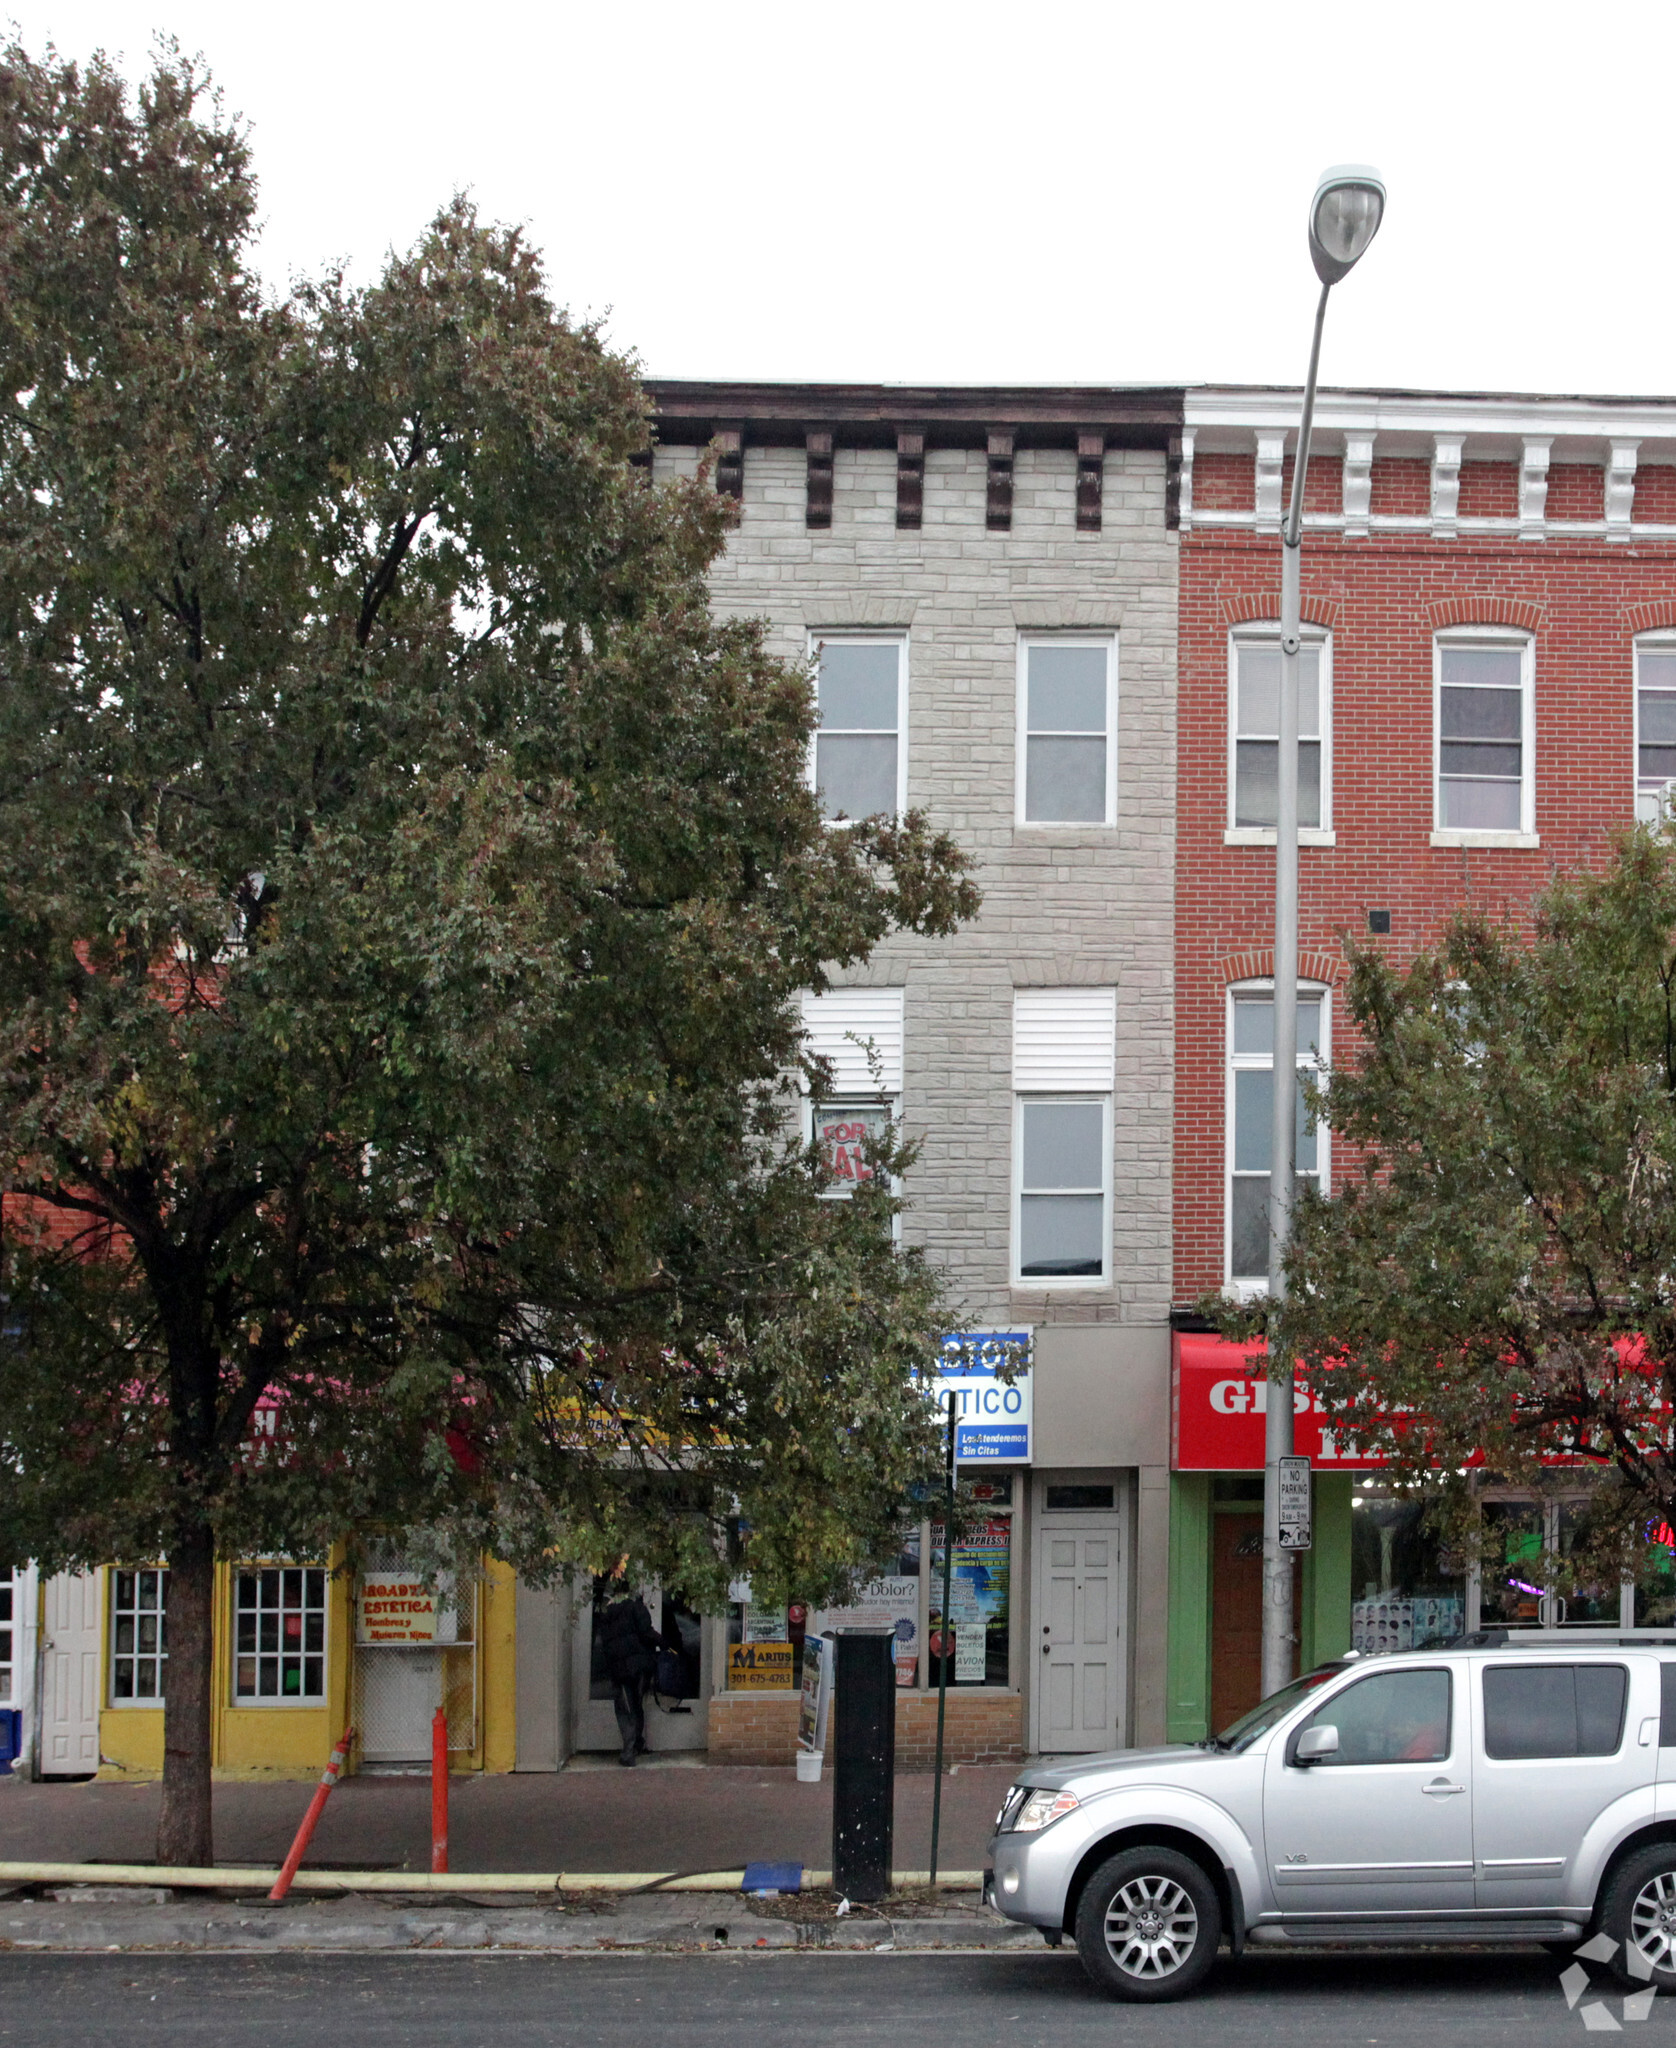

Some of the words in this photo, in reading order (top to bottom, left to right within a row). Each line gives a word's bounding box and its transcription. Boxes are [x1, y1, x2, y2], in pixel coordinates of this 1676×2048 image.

[823, 1122, 866, 1143] FOR
[962, 1446, 976, 1455] Sin
[977, 1446, 999, 1455] Citas
[1290, 1470, 1300, 1481] NO
[1281, 1484, 1307, 1494] PARKING
[871, 1583, 915, 1596] Dolor?
[363, 1600, 433, 1614] ESTETICA
[365, 1617, 404, 1627] Hombres
[405, 1619, 412, 1627] y
[731, 1646, 792, 1668] MARIUS
[956, 1657, 985, 1665] AVION
[731, 1674, 791, 1684] 301-675-4783
